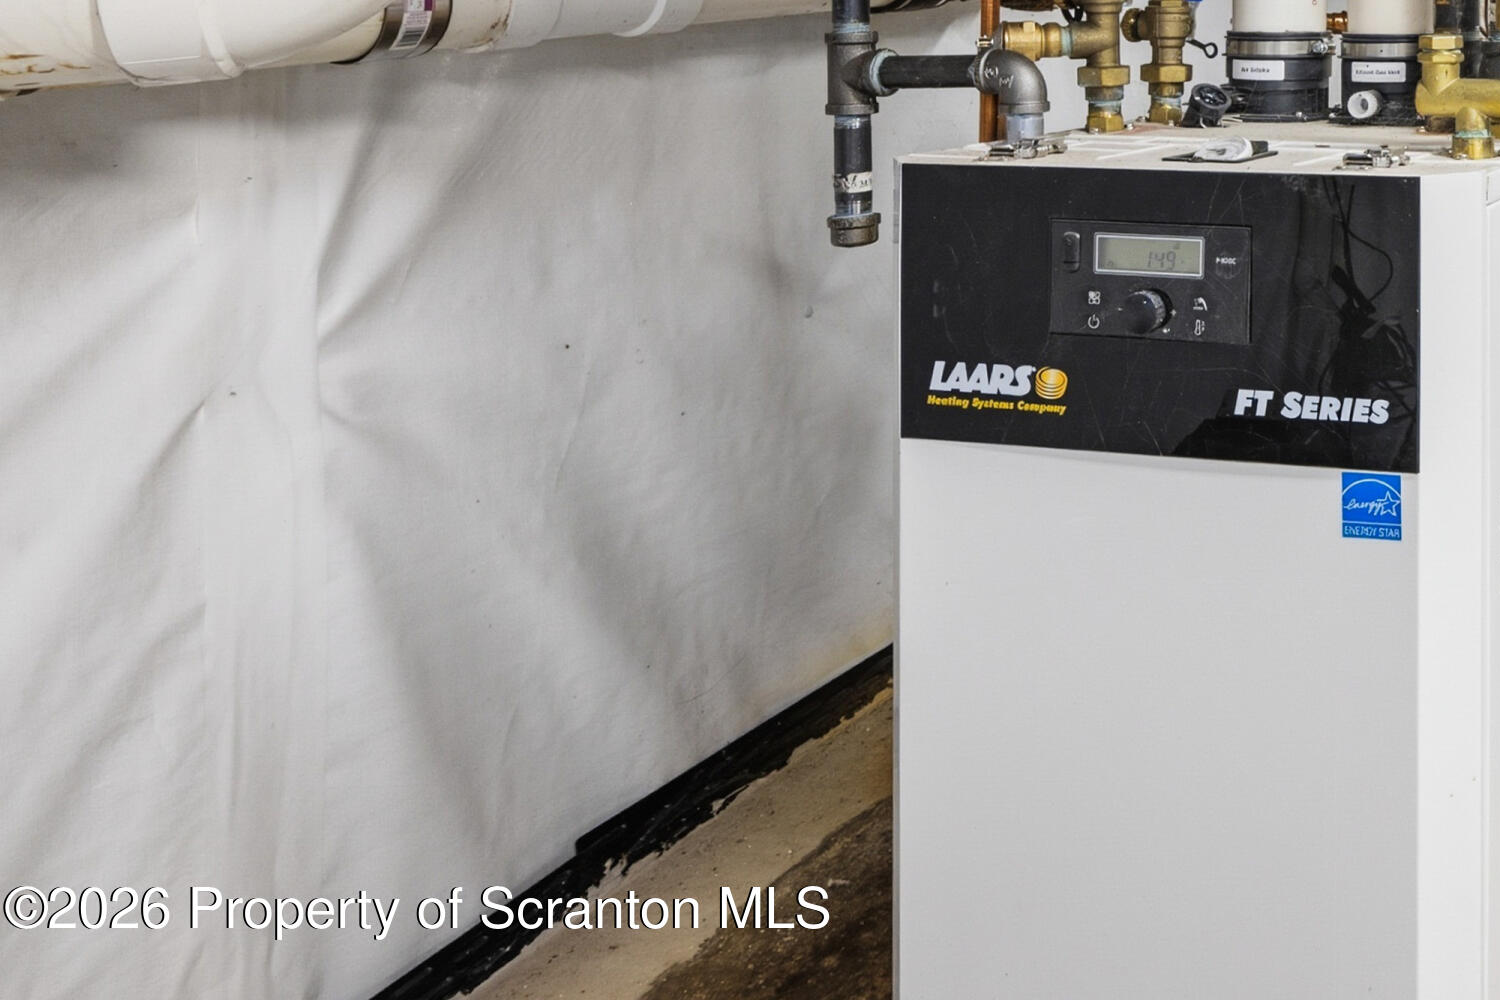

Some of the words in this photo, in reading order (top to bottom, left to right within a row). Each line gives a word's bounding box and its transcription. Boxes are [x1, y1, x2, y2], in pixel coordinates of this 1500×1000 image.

[929, 360, 1034, 397] LAARS
[927, 394, 969, 409] Heating
[972, 397, 1014, 410] Systems
[1017, 401, 1067, 415] Company
[1234, 388, 1274, 416] FT
[1280, 391, 1390, 424] SERIES
[1344, 525, 1377, 536] ENERGY
[1378, 527, 1400, 538] STAR
